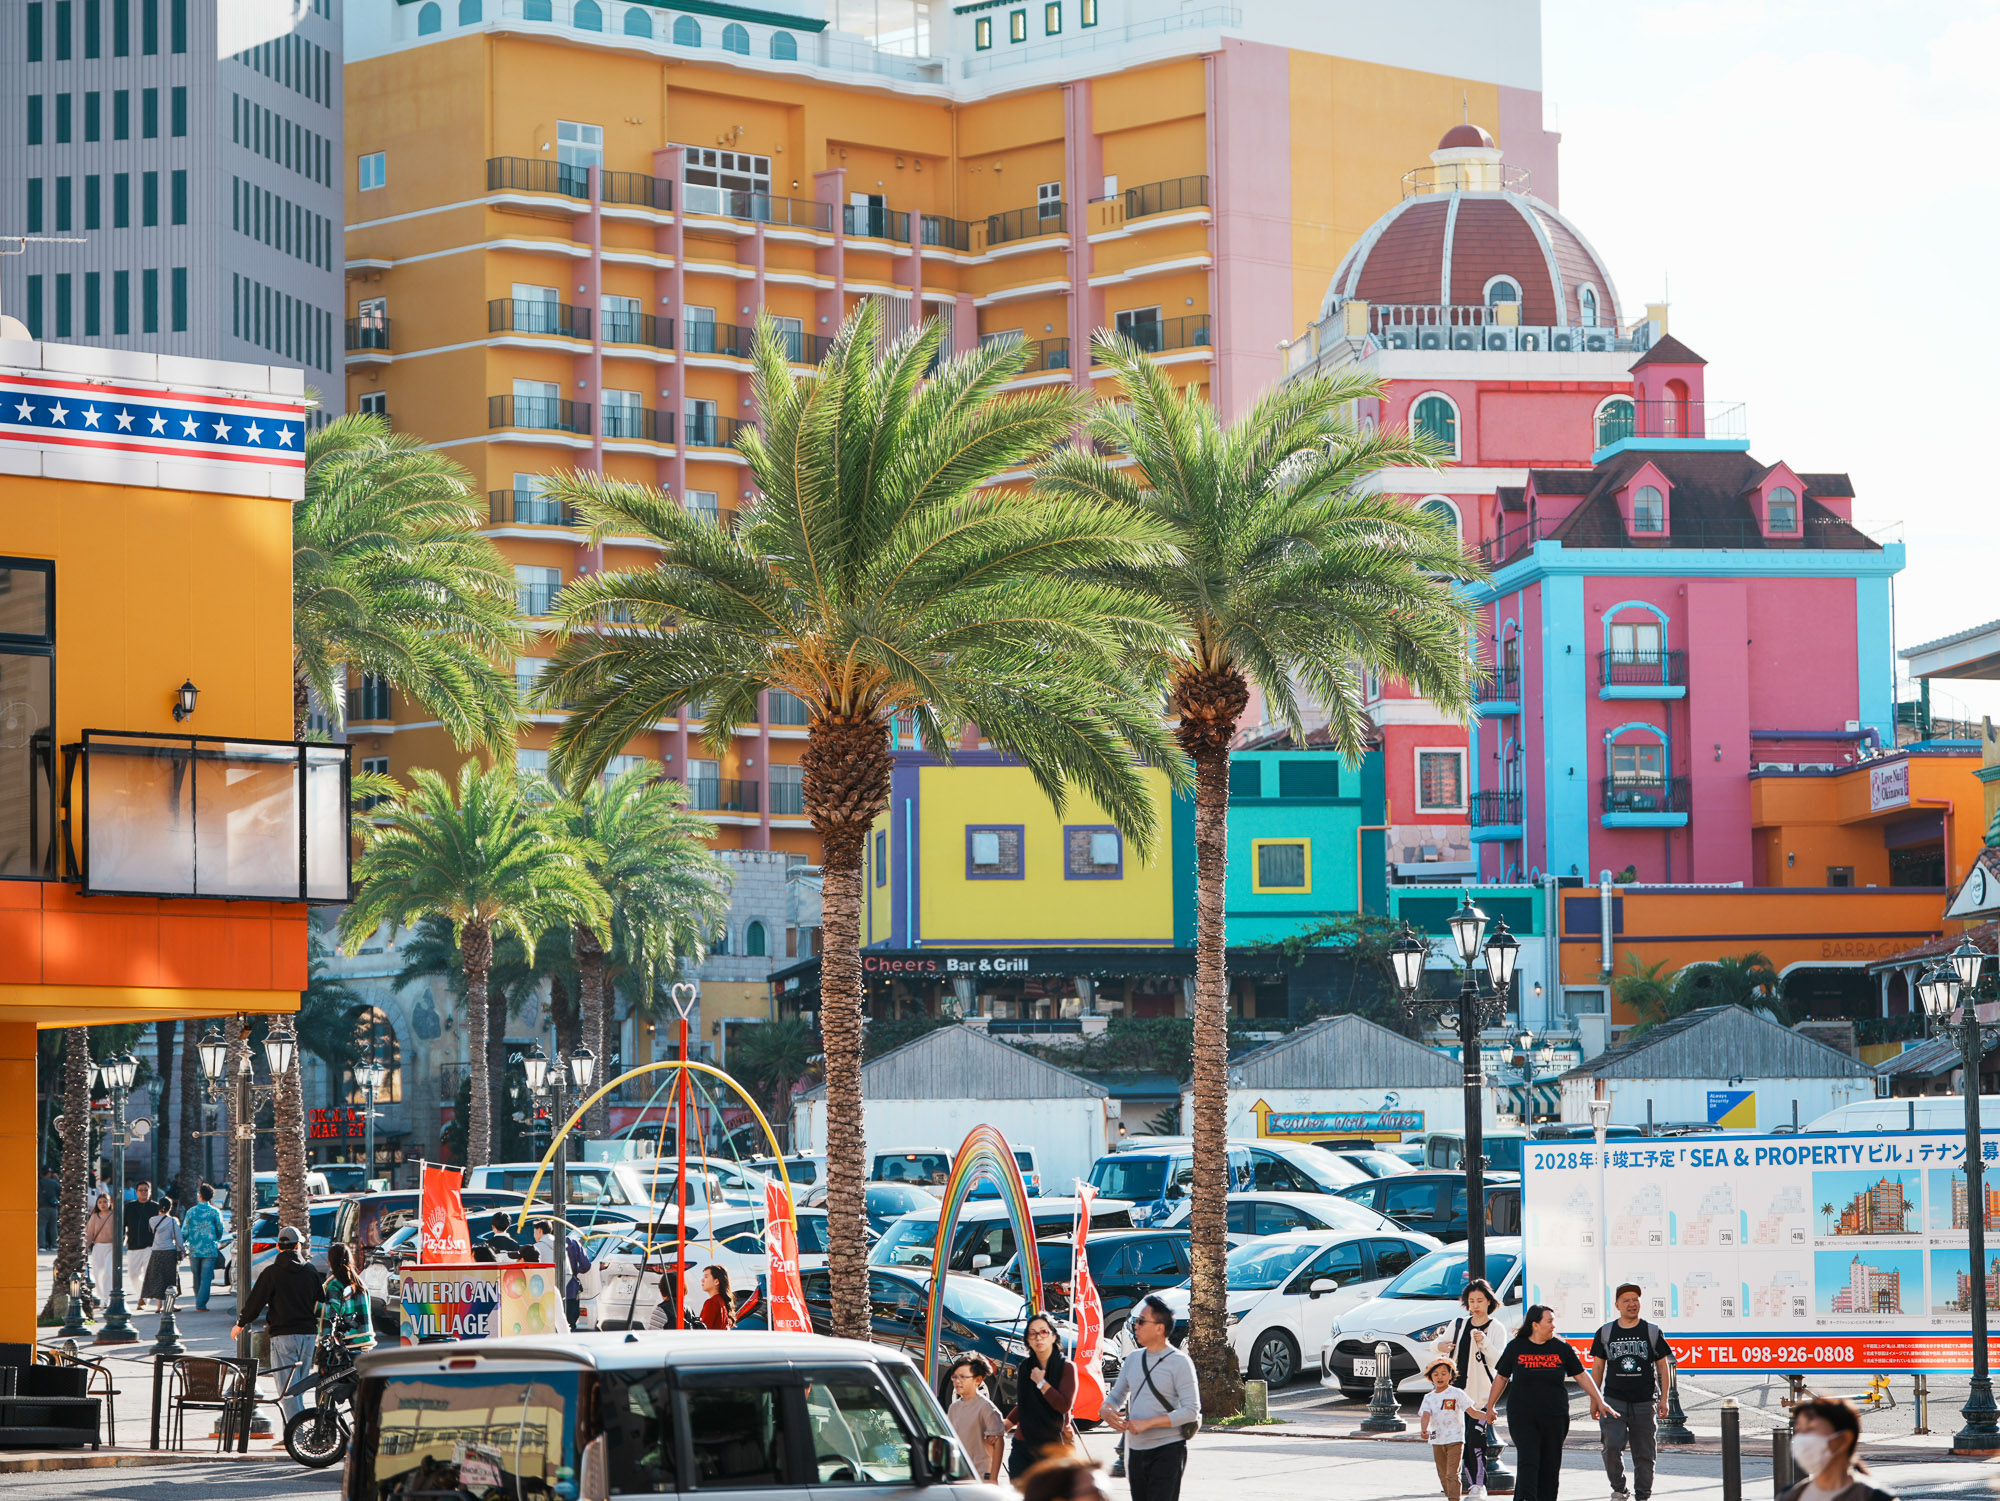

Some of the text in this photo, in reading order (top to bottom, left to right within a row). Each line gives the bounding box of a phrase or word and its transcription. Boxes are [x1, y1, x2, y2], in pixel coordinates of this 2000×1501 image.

[864, 957, 1029, 972] Cheers Bar & Grill
[309, 1122, 365, 1138] MARET
[1271, 1115, 1329, 1131] Leather
[1334, 1113, 1369, 1129] Work
[400, 1280, 499, 1304] AMERICAN
[410, 1313, 490, 1335] VILLAGE
[1517, 1353, 1563, 1364] STRANGER
[1609, 1340, 1649, 1361] CELTICS
[1707, 1346, 1738, 1363] TEL
[1741, 1345, 1855, 1363] 098-926-0808
[1523, 1360, 1557, 1369] THINGS
